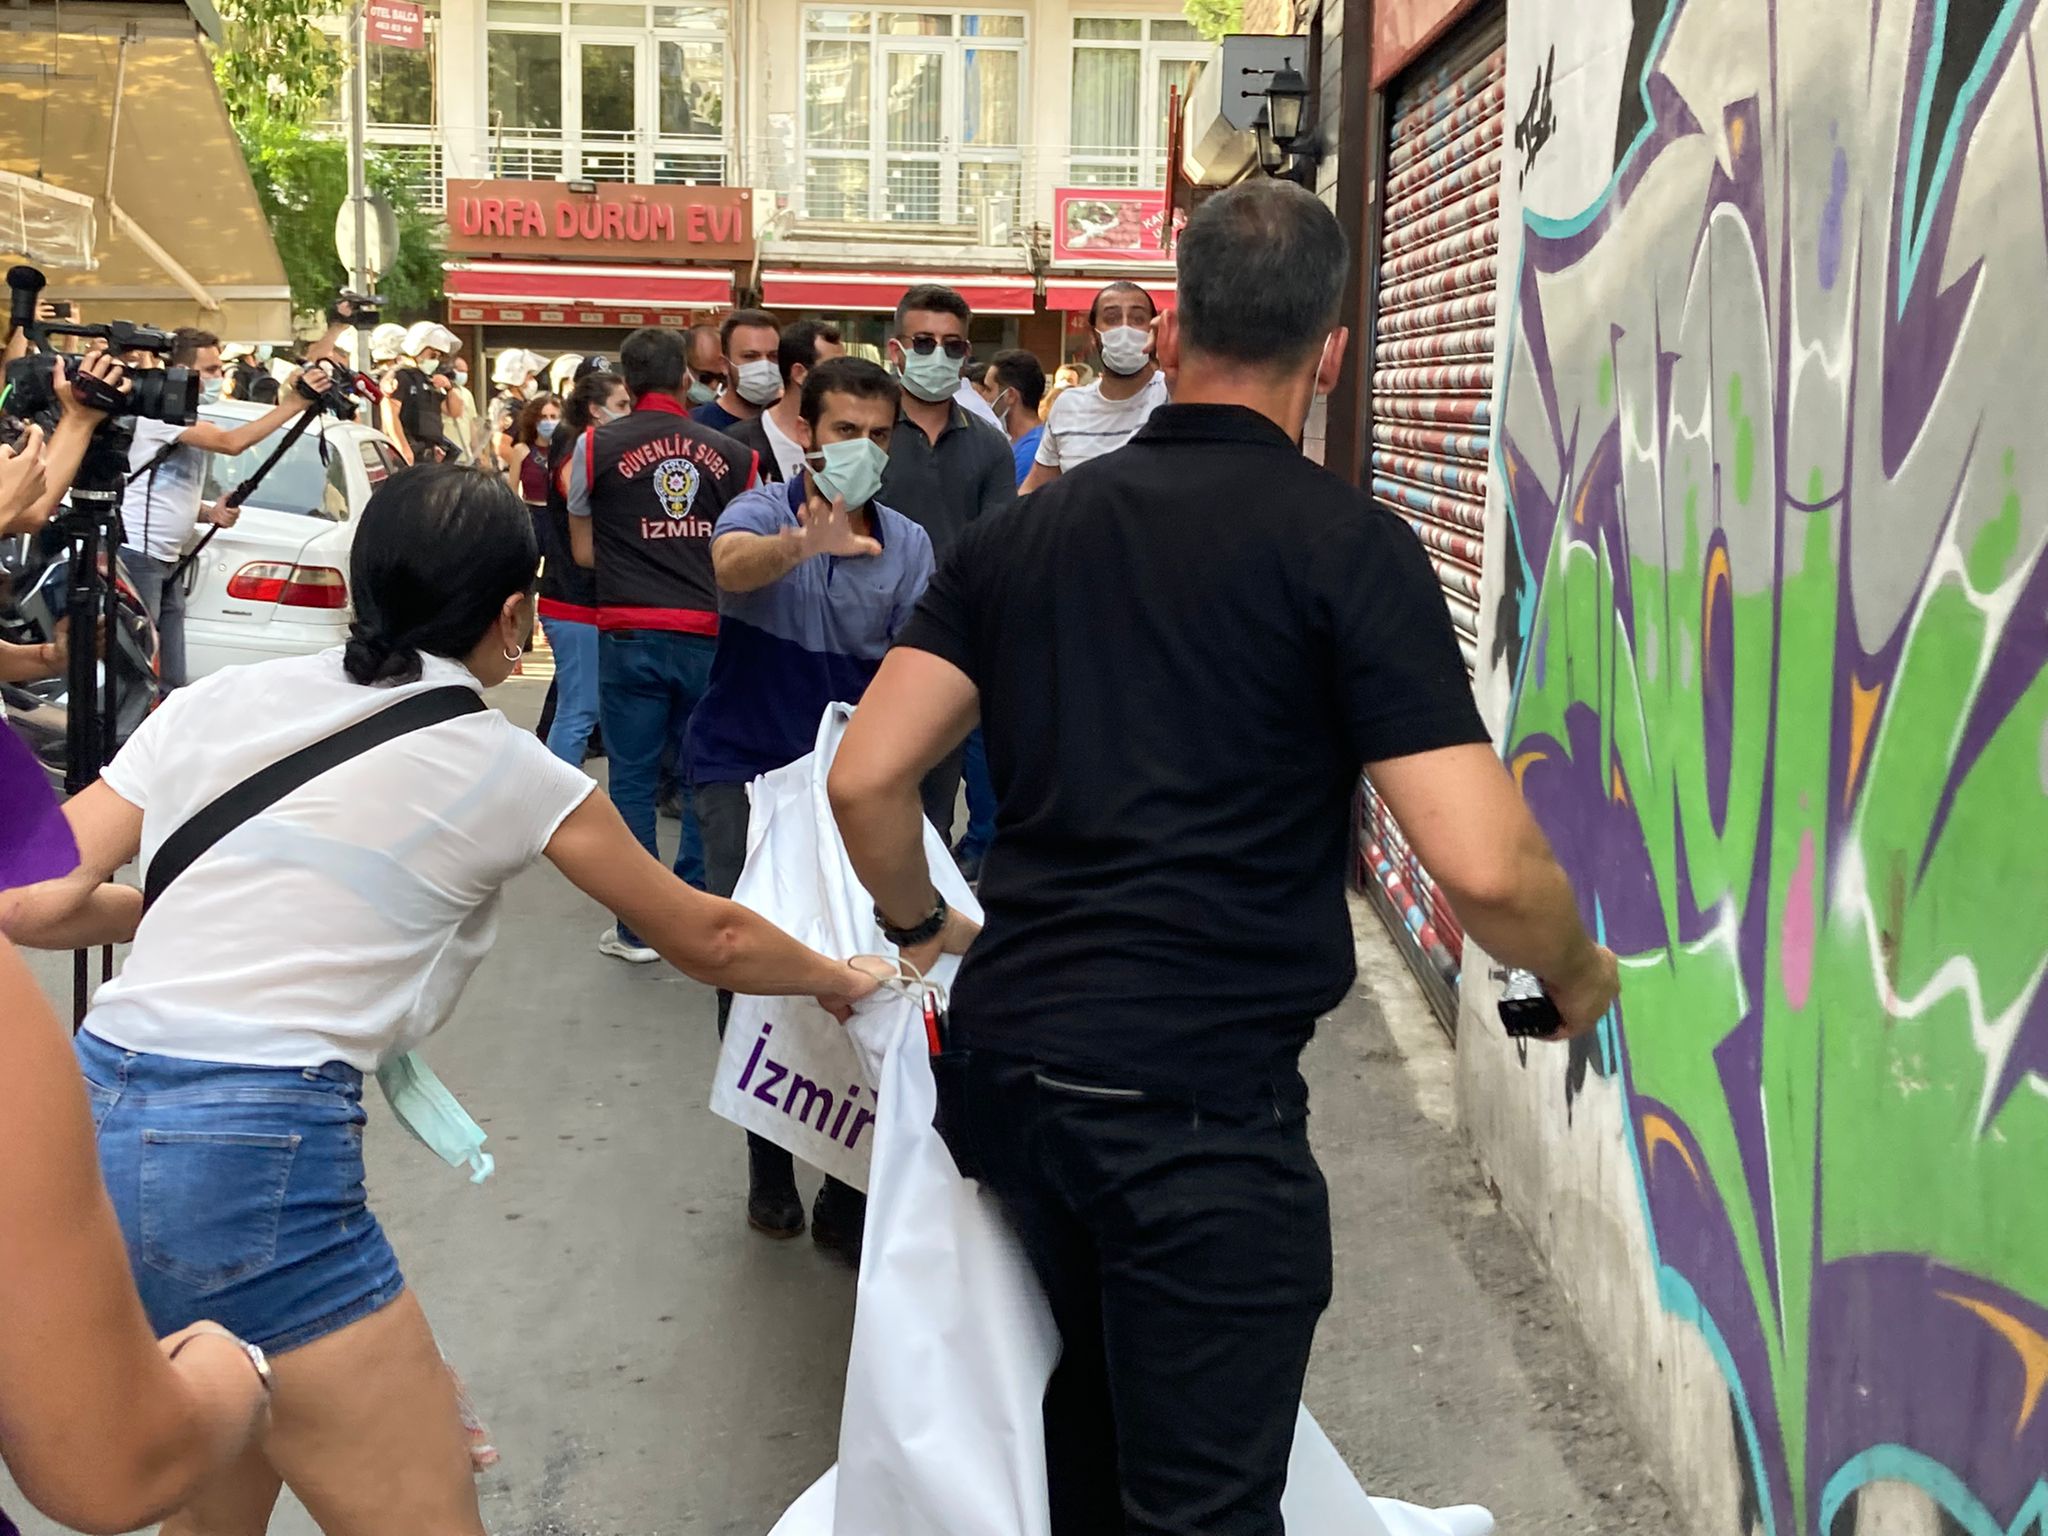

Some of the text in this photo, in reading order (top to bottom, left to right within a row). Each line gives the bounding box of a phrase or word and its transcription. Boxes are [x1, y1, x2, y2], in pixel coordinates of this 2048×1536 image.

[370, 6, 391, 19] OTEL
[458, 194, 743, 244] URFA DÜRÜM EVİ
[618, 433, 730, 481] GÜVENLİK ŞUBE
[640, 515, 713, 540] İZMİR
[736, 1021, 876, 1150] İzmir
